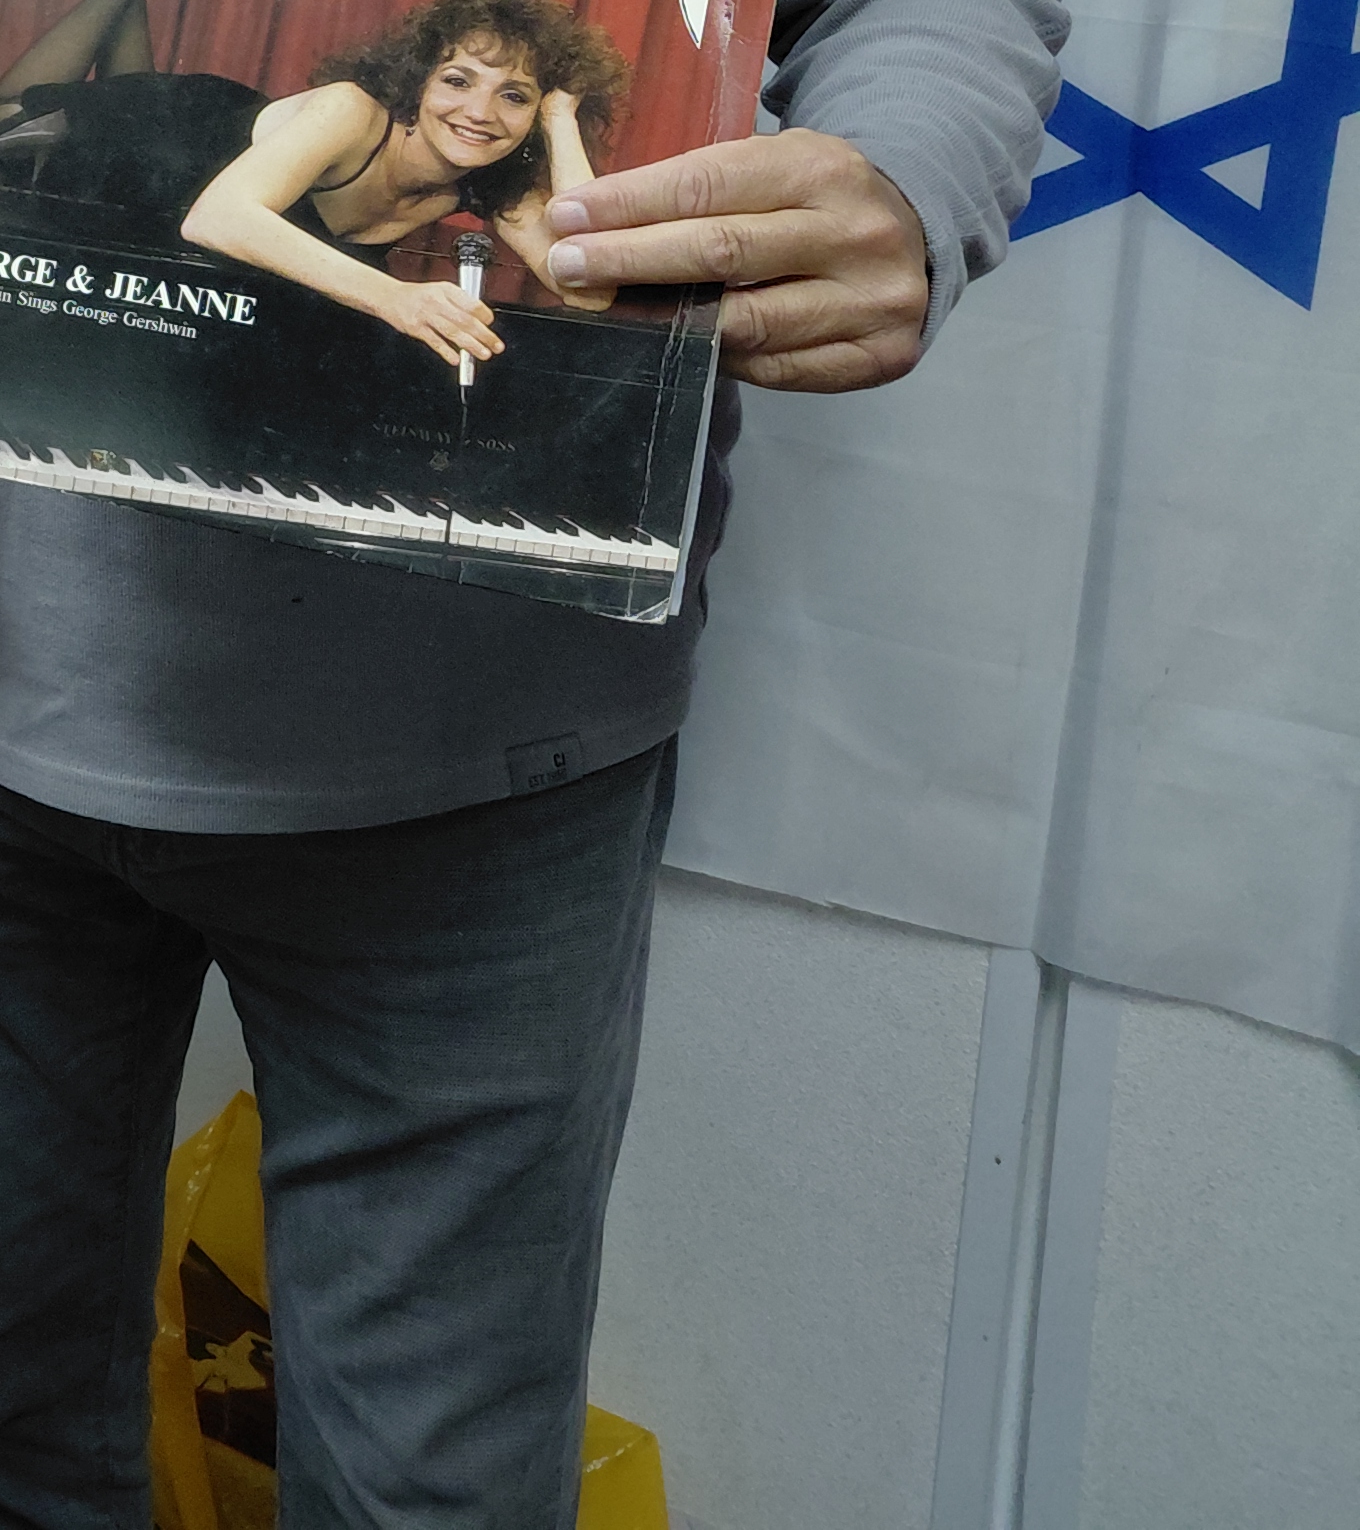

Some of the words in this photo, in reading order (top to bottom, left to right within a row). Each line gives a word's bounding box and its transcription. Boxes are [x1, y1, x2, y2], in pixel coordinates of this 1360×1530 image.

[16, 290, 58, 314] Sings
[62, 299, 118, 325] George
[123, 311, 198, 339] Gershwin
[65, 264, 95, 295] &
[105, 271, 257, 325] JEANNE
